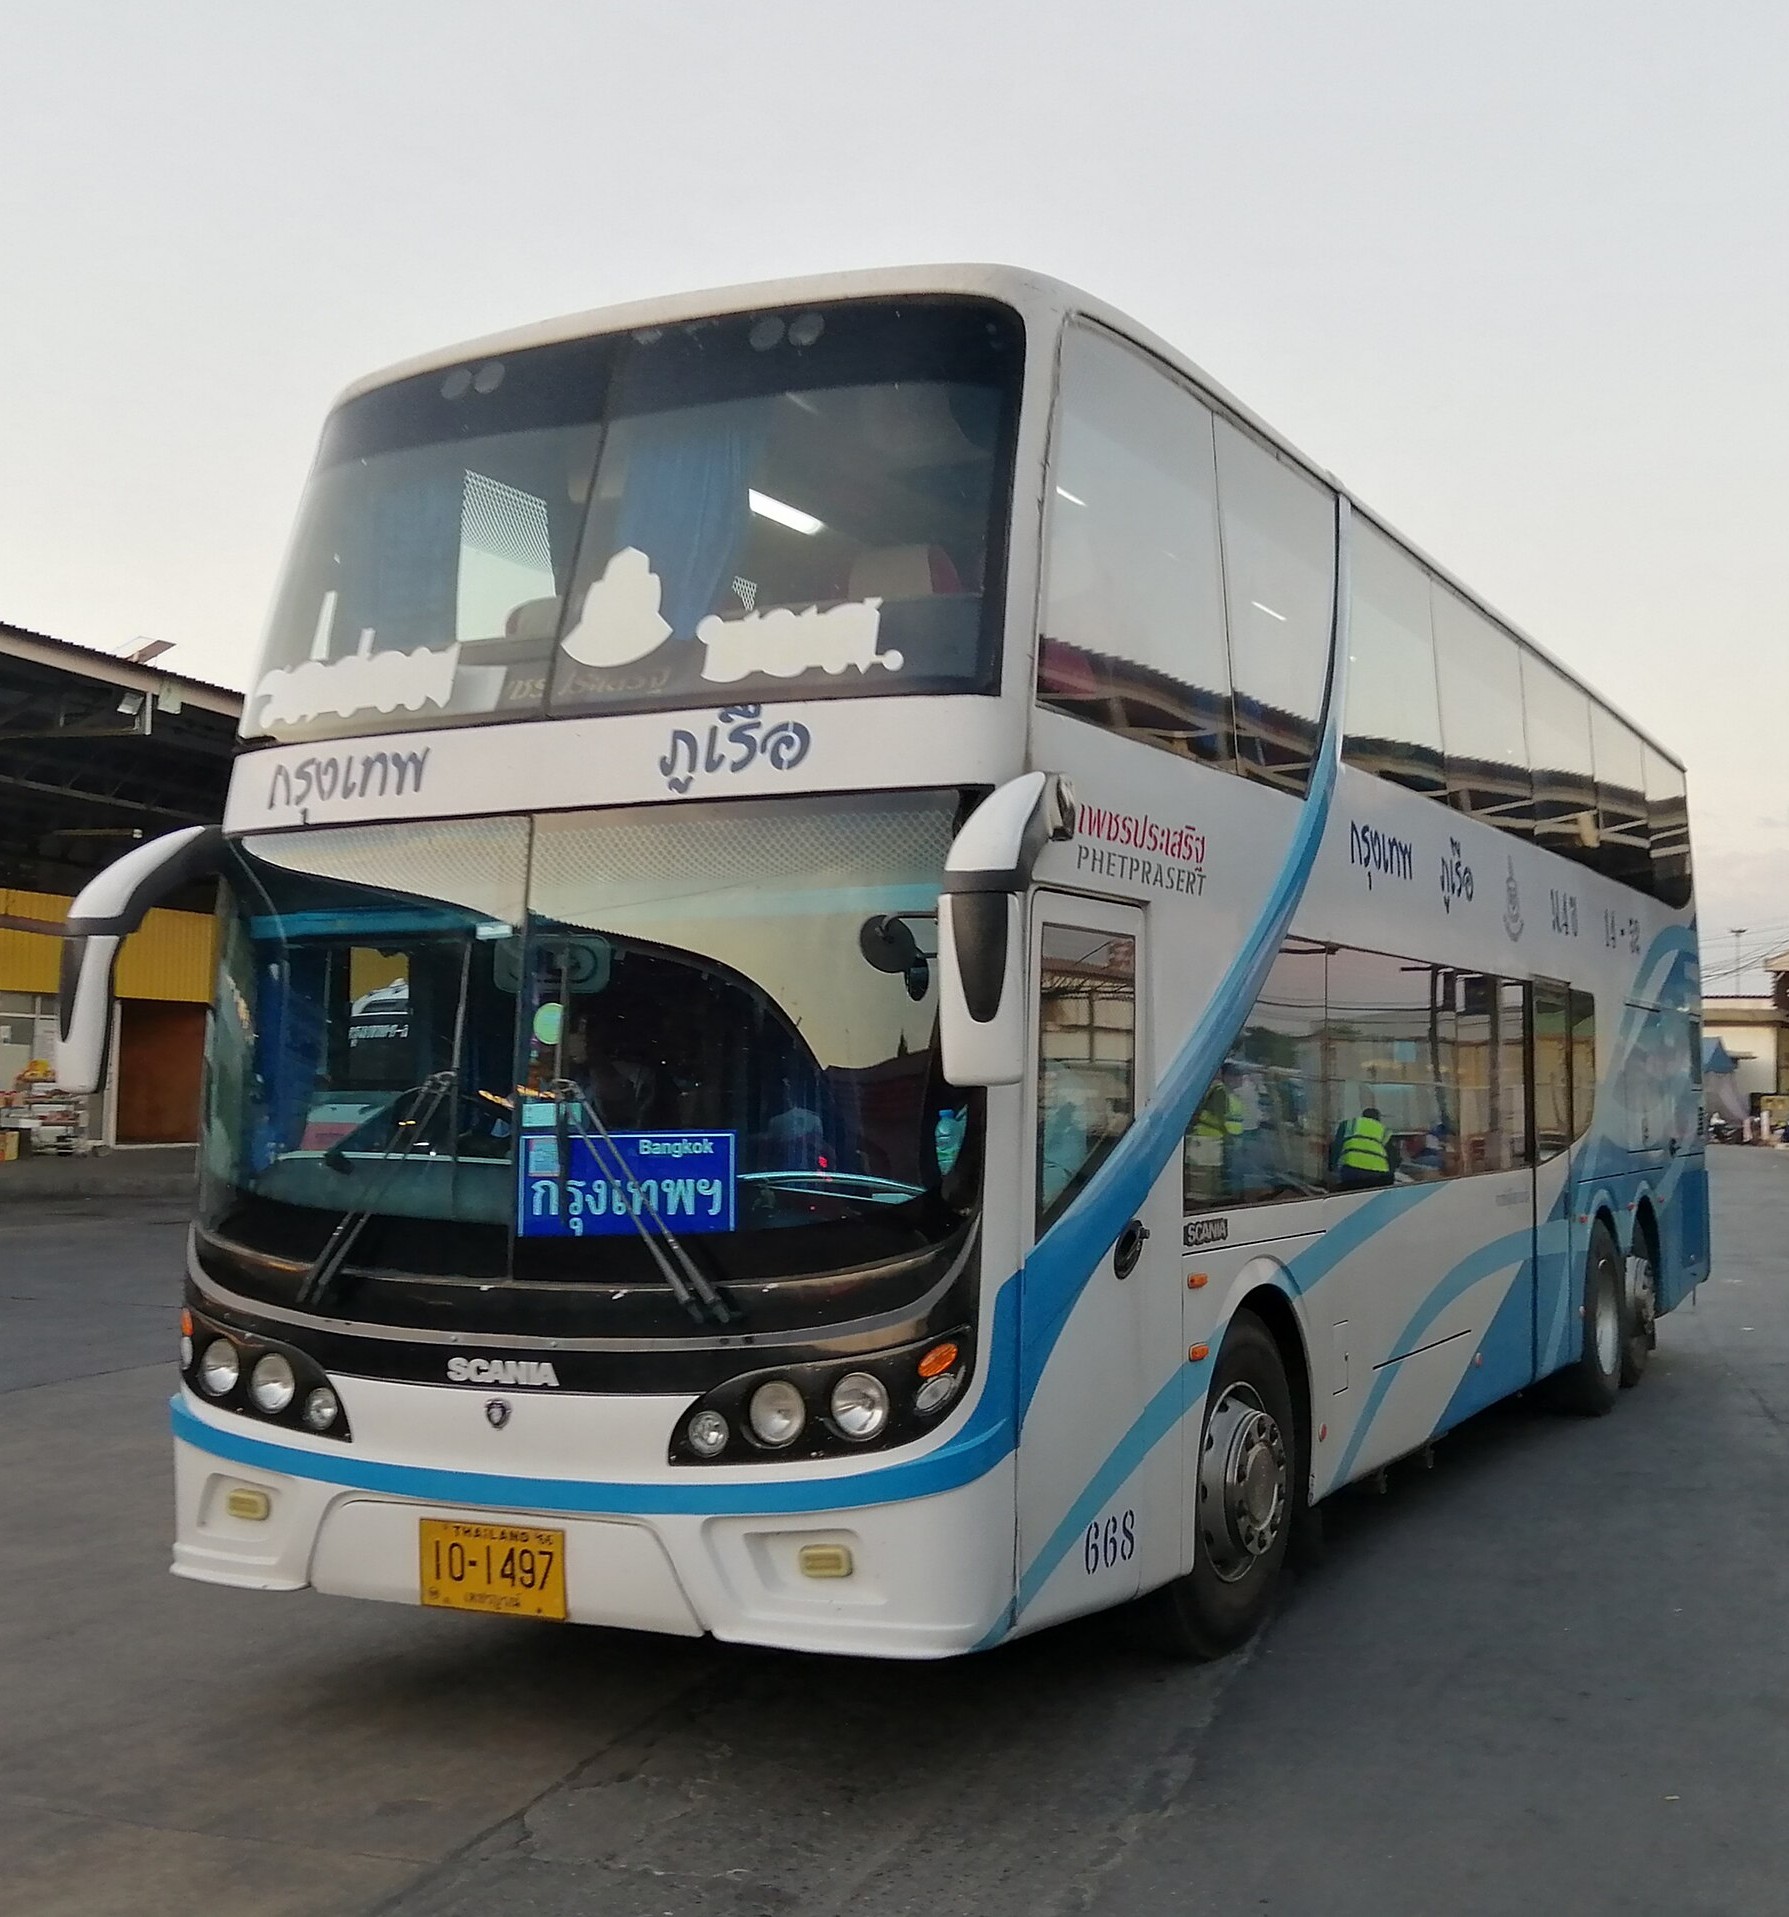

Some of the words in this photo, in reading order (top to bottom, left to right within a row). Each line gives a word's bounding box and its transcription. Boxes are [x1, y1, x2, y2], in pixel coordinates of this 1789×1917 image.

[1076, 844, 1207, 897] PHETPRASERT
[638, 1138, 715, 1158] Bangkok
[530, 1177, 723, 1237] กรุงเทพฯ
[1186, 1218, 1228, 1245] SCANIA
[446, 1356, 561, 1388] SCANIA
[452, 1525, 529, 1542] THAILAND
[1084, 1508, 1135, 1575] 668
[434, 1540, 555, 1591] 10-1497
